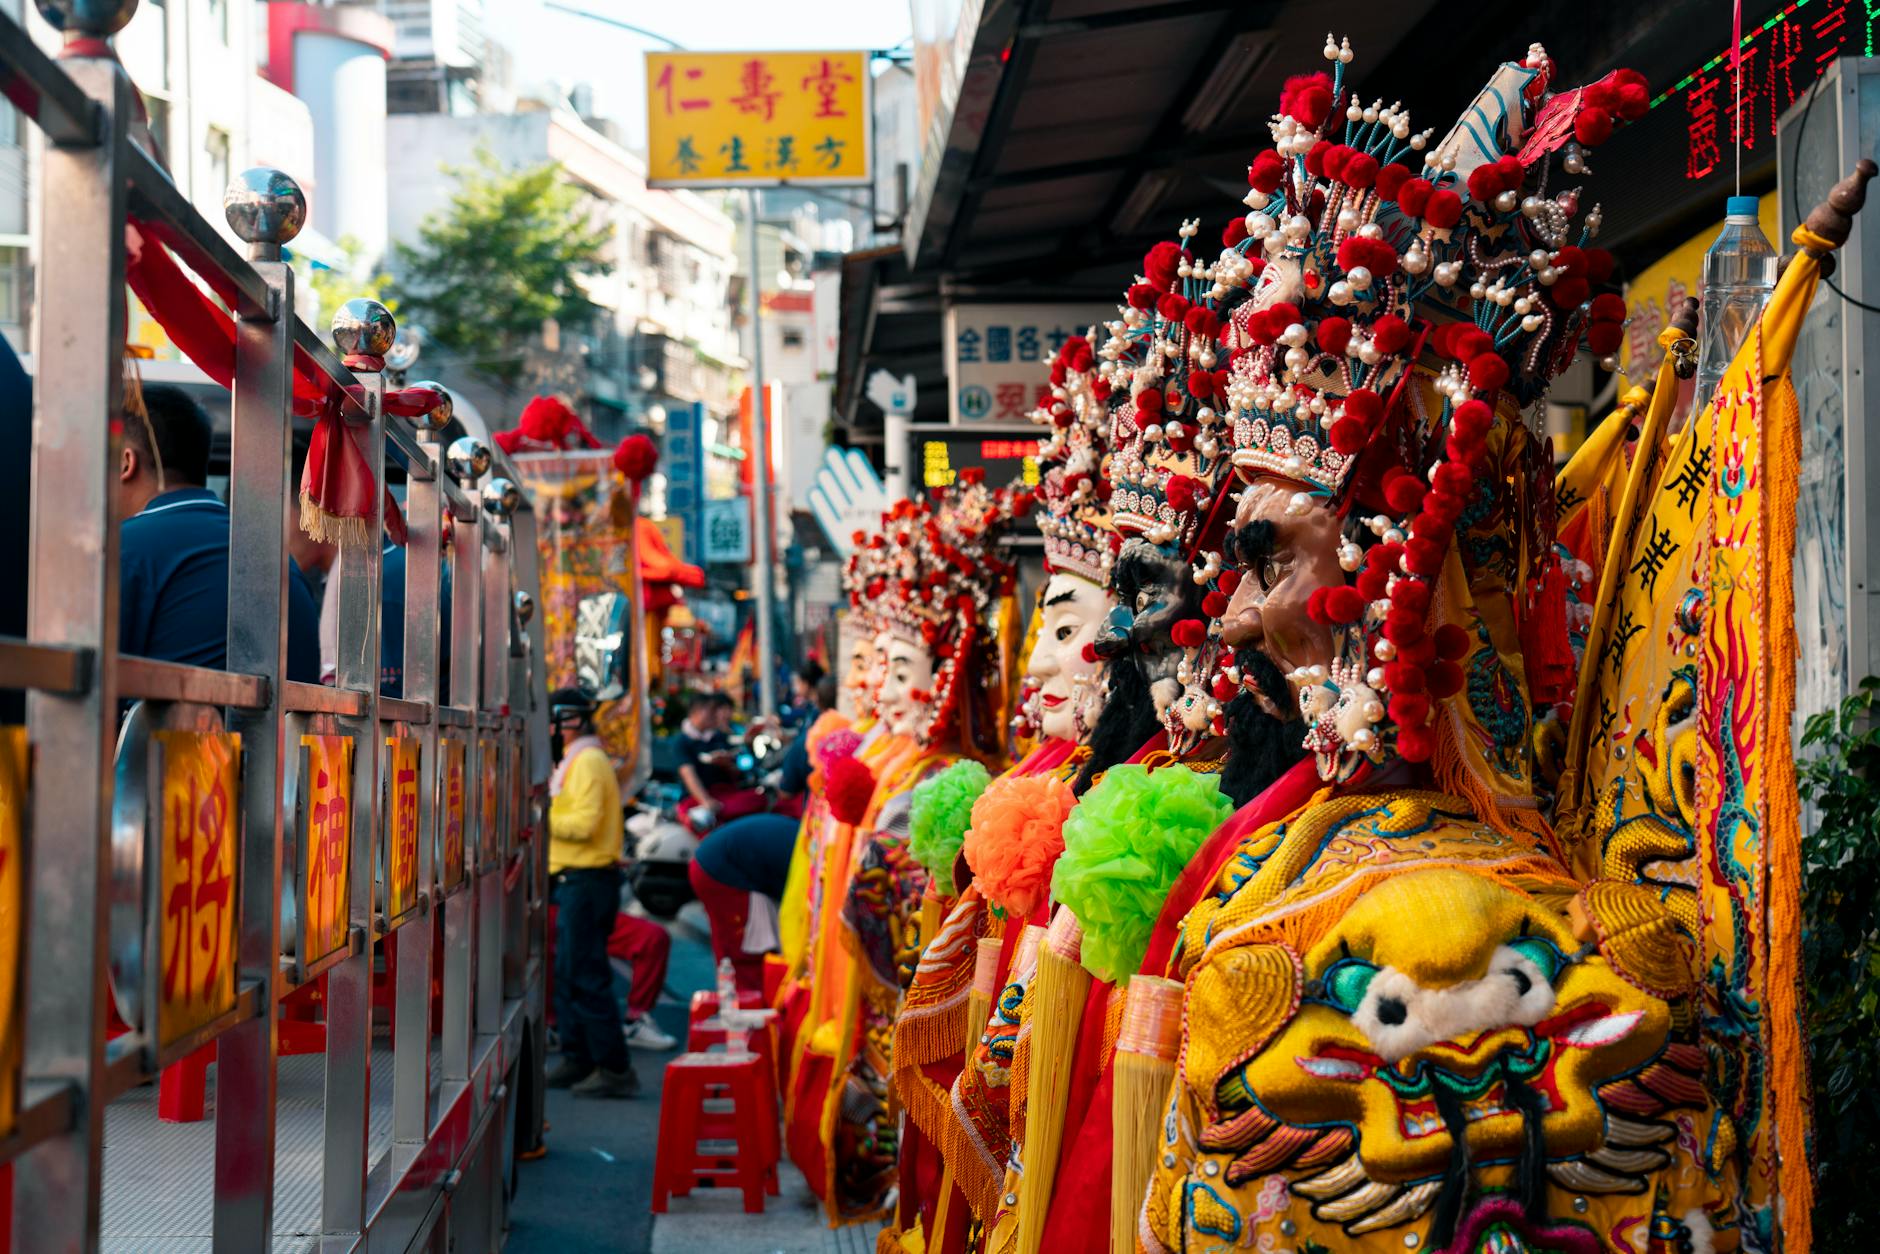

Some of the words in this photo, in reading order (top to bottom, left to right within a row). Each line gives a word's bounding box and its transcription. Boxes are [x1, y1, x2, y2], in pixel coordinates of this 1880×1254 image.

[655, 57, 854, 123] 仁壽堂
[670, 134, 846, 174] 養生漢方
[309, 764, 347, 956] 神
